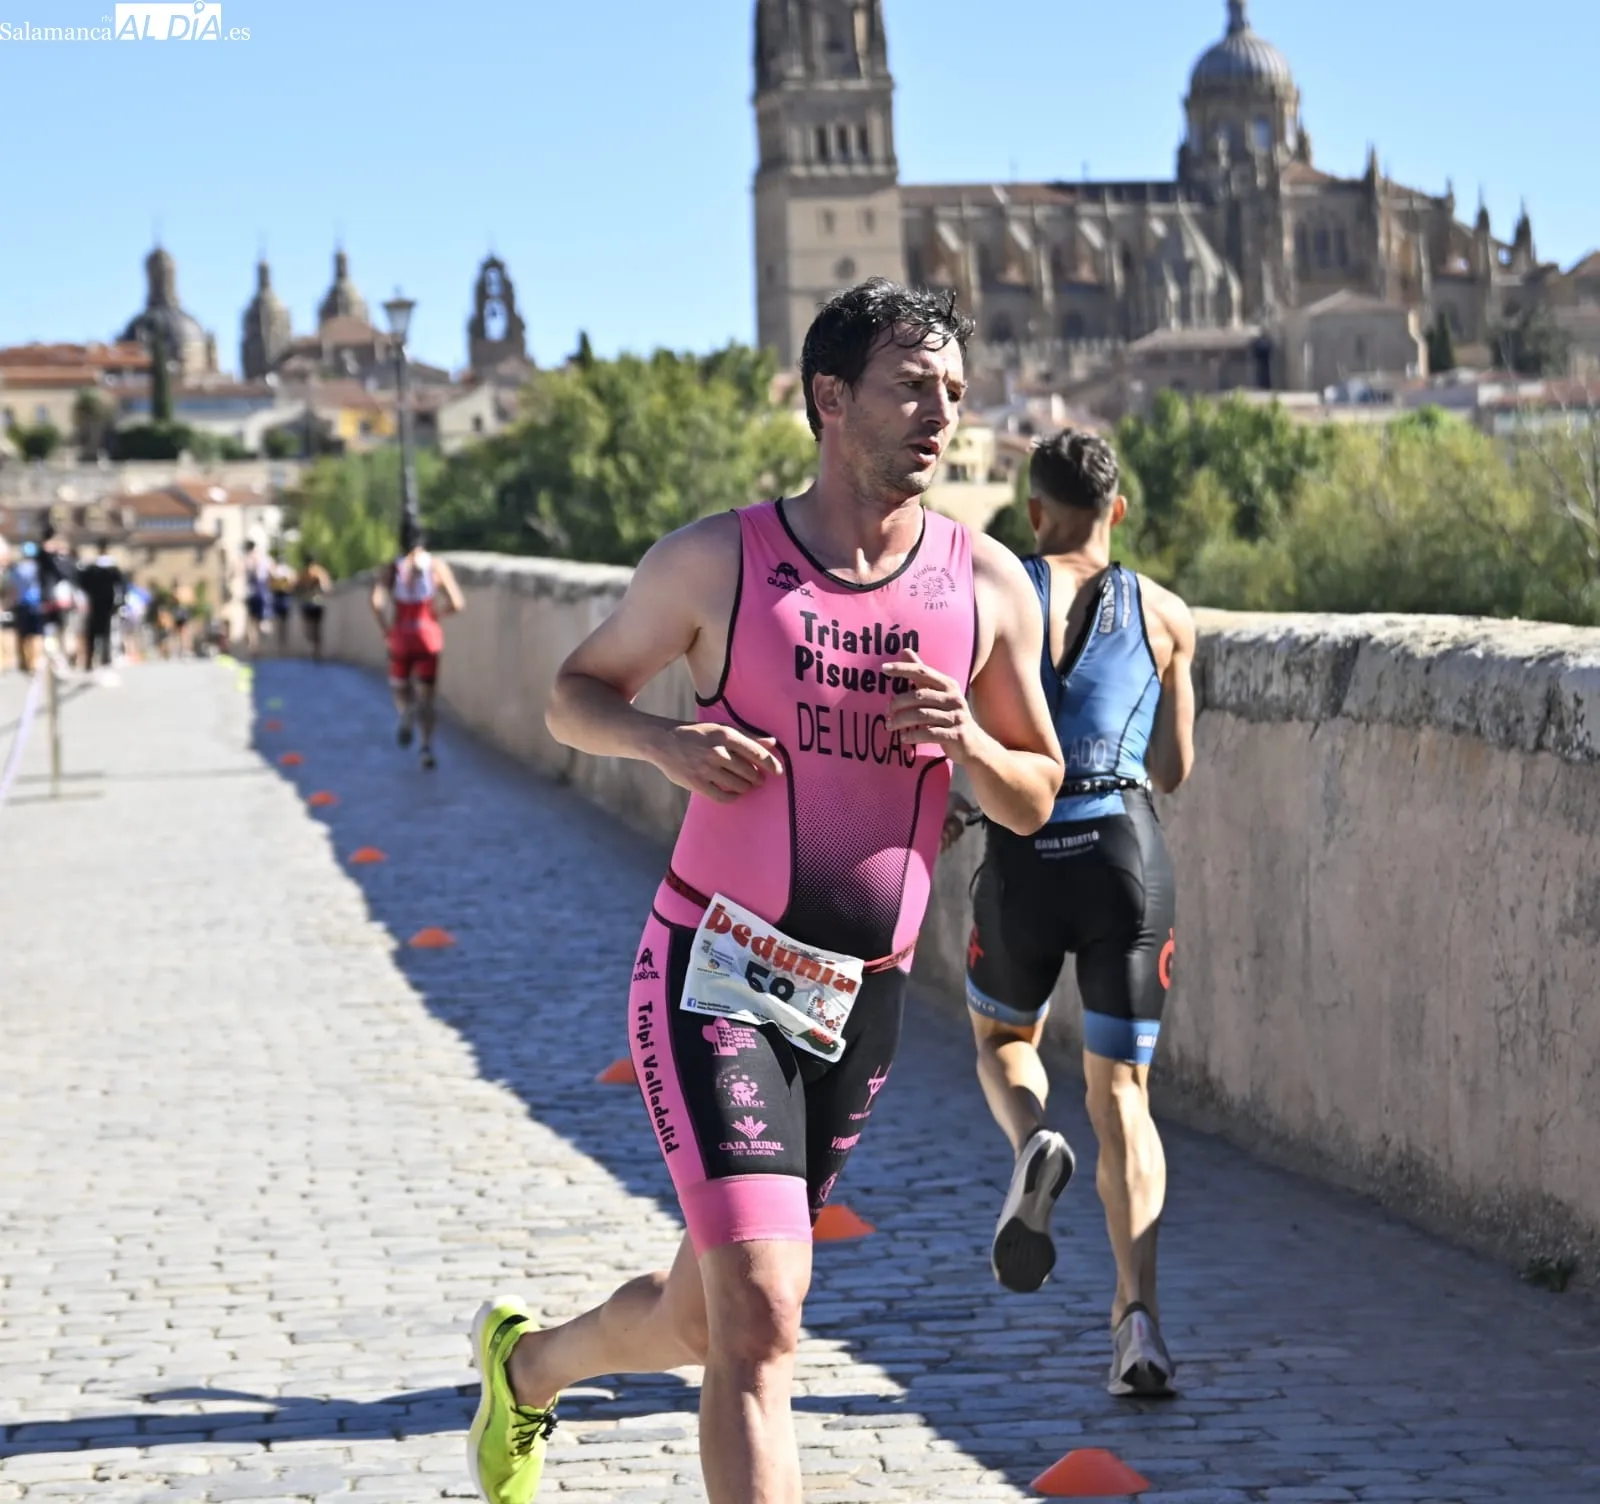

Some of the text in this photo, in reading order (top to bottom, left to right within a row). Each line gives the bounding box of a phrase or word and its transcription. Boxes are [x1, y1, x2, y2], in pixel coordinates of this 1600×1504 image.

[800, 610, 919, 655] Triatlón
[794, 645, 917, 695] Pisuer
[797, 702, 833, 755] DE
[1067, 735, 1107, 771] ADO
[636, 1001, 680, 1155] Tripi Valladolid
[718, 1140, 785, 1151] CAJA RURAL
